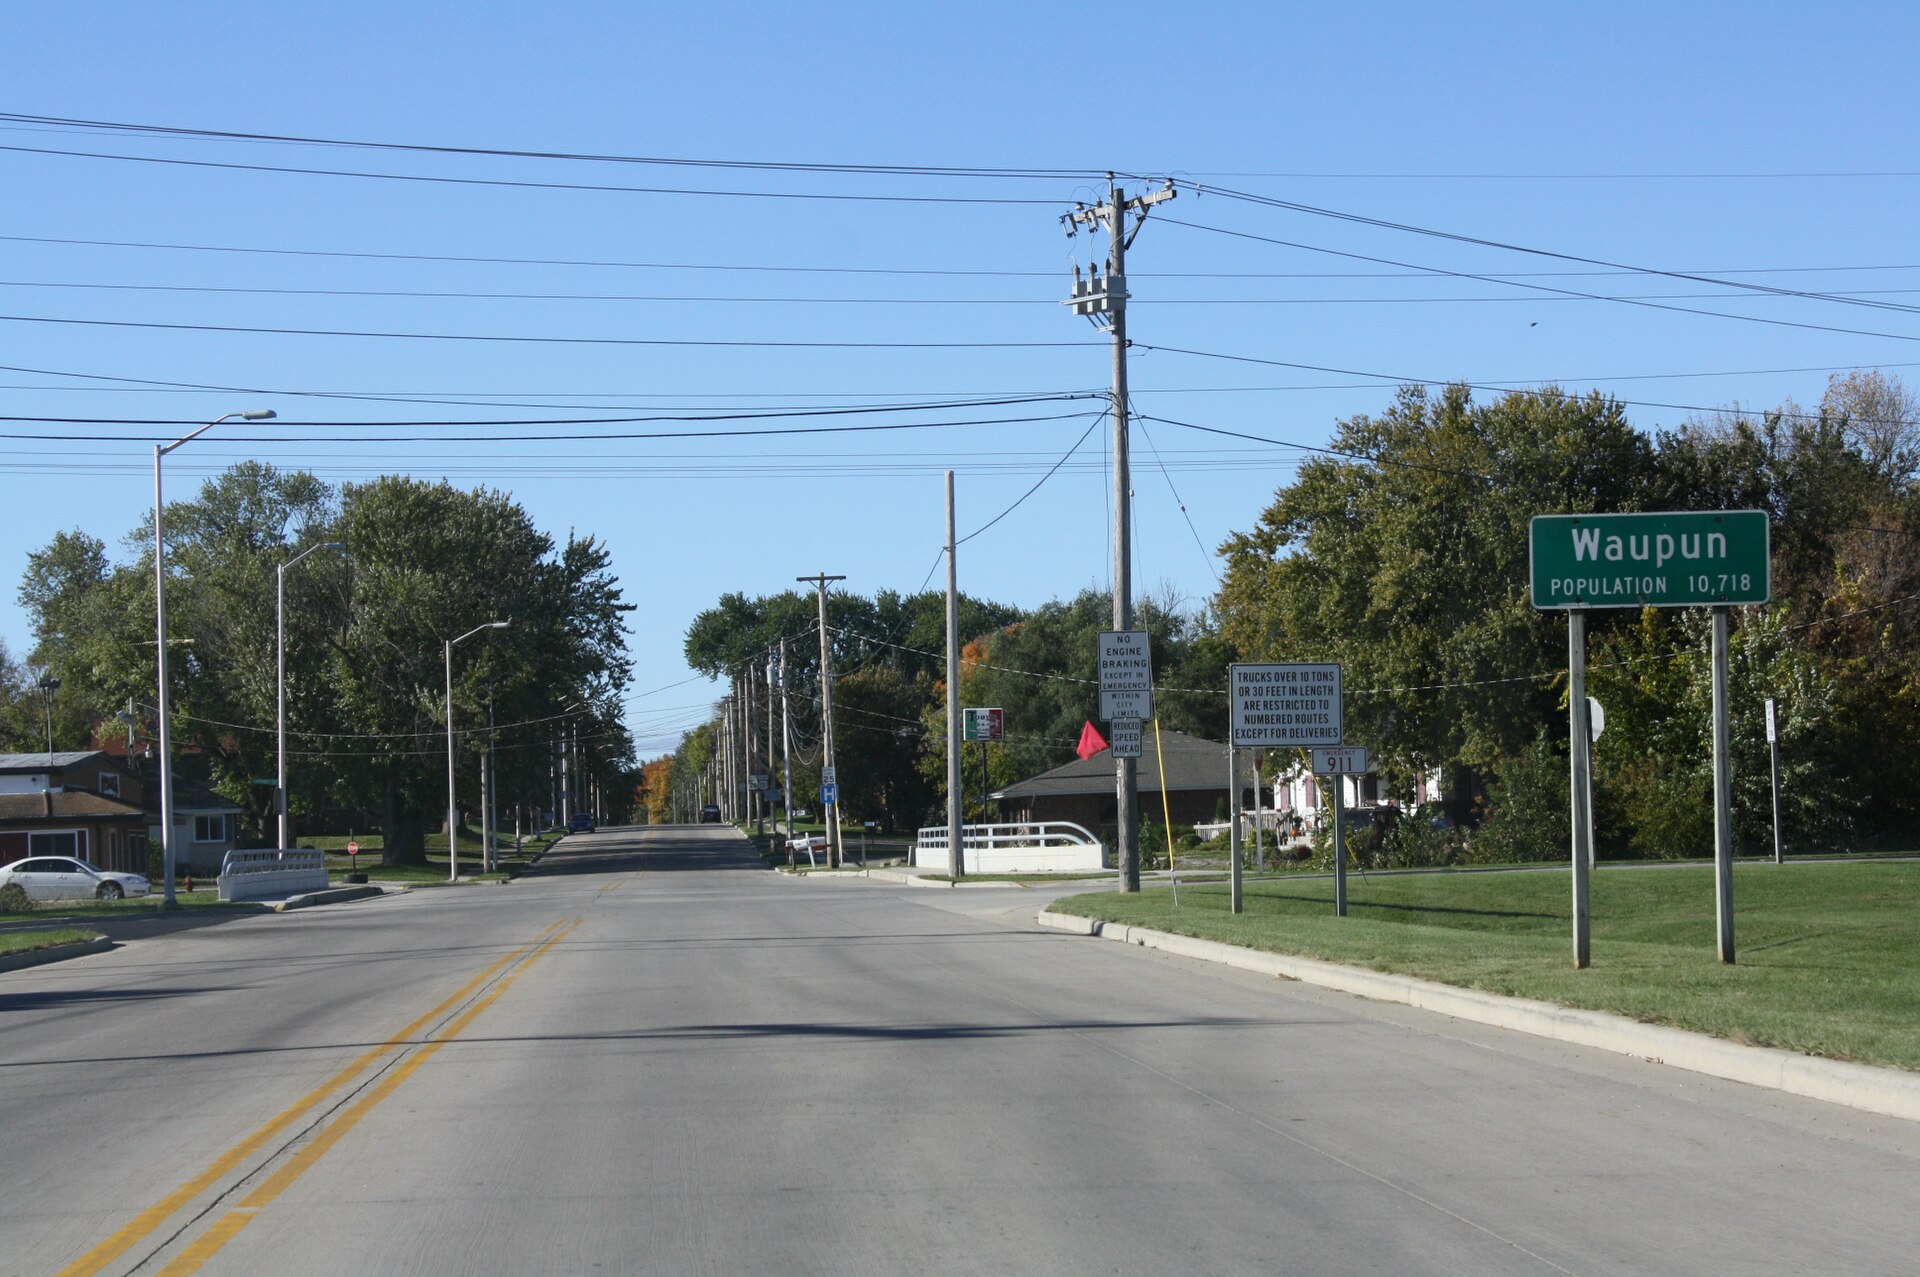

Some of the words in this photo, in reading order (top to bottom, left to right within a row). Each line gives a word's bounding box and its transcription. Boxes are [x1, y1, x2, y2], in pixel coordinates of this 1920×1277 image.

[1571, 527, 1727, 568] Waupun
[1551, 576, 1667, 596] POPULATION
[1689, 574, 1751, 596] 10,718
[1117, 635, 1130, 643] NO
[1106, 647, 1142, 656] ENGINE
[1102, 659, 1147, 669] BRAKING
[1238, 672, 1272, 683] TRUCKS
[1274, 672, 1297, 682] OVER
[1300, 672, 1309, 681] 10
[1311, 671, 1335, 682] TONS
[1103, 682, 1147, 690] EMERGENCY
[1238, 686, 1250, 697] OR
[1252, 686, 1263, 697] 30
[1266, 686, 1287, 697] FEET
[1289, 686, 1298, 696] IN
[1300, 685, 1334, 696] LENGTH
[1243, 700, 1261, 711] ARE
[1263, 699, 1316, 711] RESTRICTED
[1318, 699, 1329, 710] TO
[1244, 714, 1293, 725] NUMBERED
[1295, 713, 1329, 724] ROUTES
[1113, 722, 1140, 730] REDUCED
[1114, 733, 1140, 742] SPEED
[1235, 728, 1268, 739] EXCEPT
[1270, 728, 1287, 739] FOR
[1289, 727, 1339, 738] DELIVERIES
[1114, 744, 1140, 753] AHEAD
[1327, 757, 1352, 771] 911
[823, 775, 834, 783] 25
[824, 787, 835, 801] H
